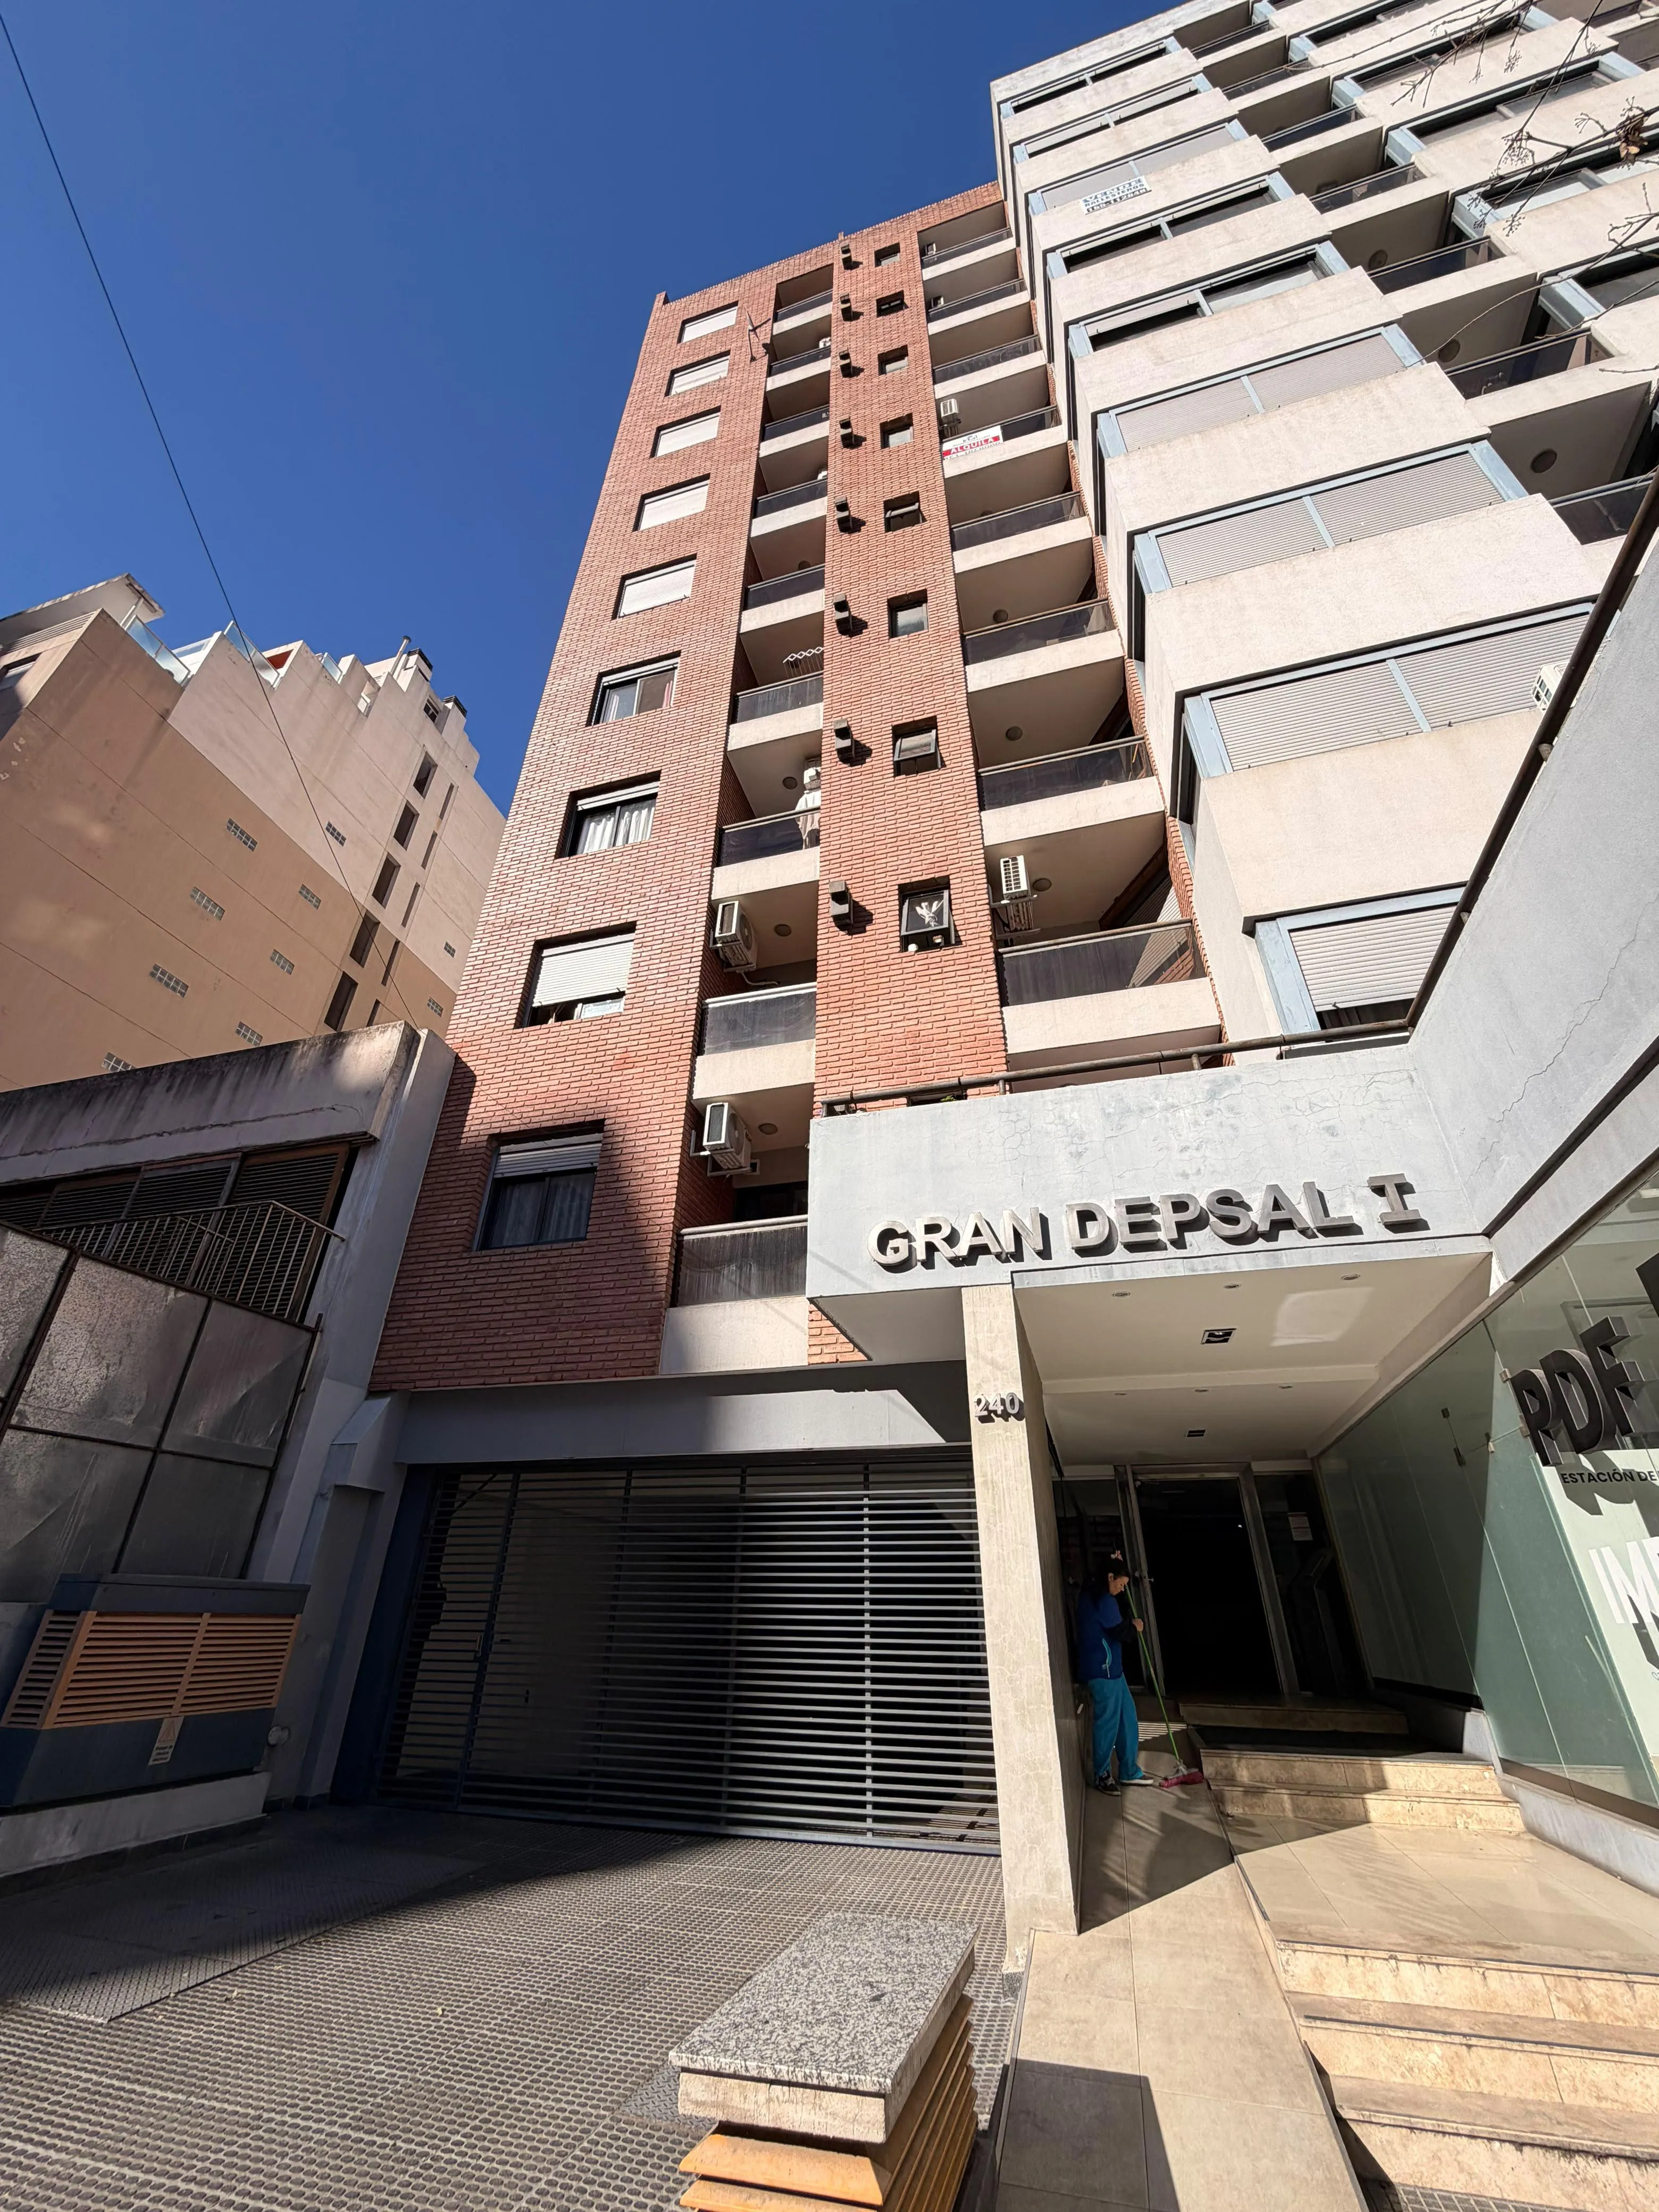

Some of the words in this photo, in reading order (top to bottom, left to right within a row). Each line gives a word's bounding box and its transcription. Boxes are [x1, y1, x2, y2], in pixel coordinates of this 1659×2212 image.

[950, 438, 994, 454] ALQUILA
[867, 1206, 1045, 1267] GRAN
[1066, 1181, 1355, 1250] DEPSAL
[1369, 1173, 1421, 1227] I
[974, 1392, 1019, 1417] 240
[1511, 1316, 1644, 1467] PDF
[1560, 1469, 1635, 1484] ESTACIÓN
[1636, 1471, 1657, 1481] DE
[1588, 1536, 1659, 1624] IM
